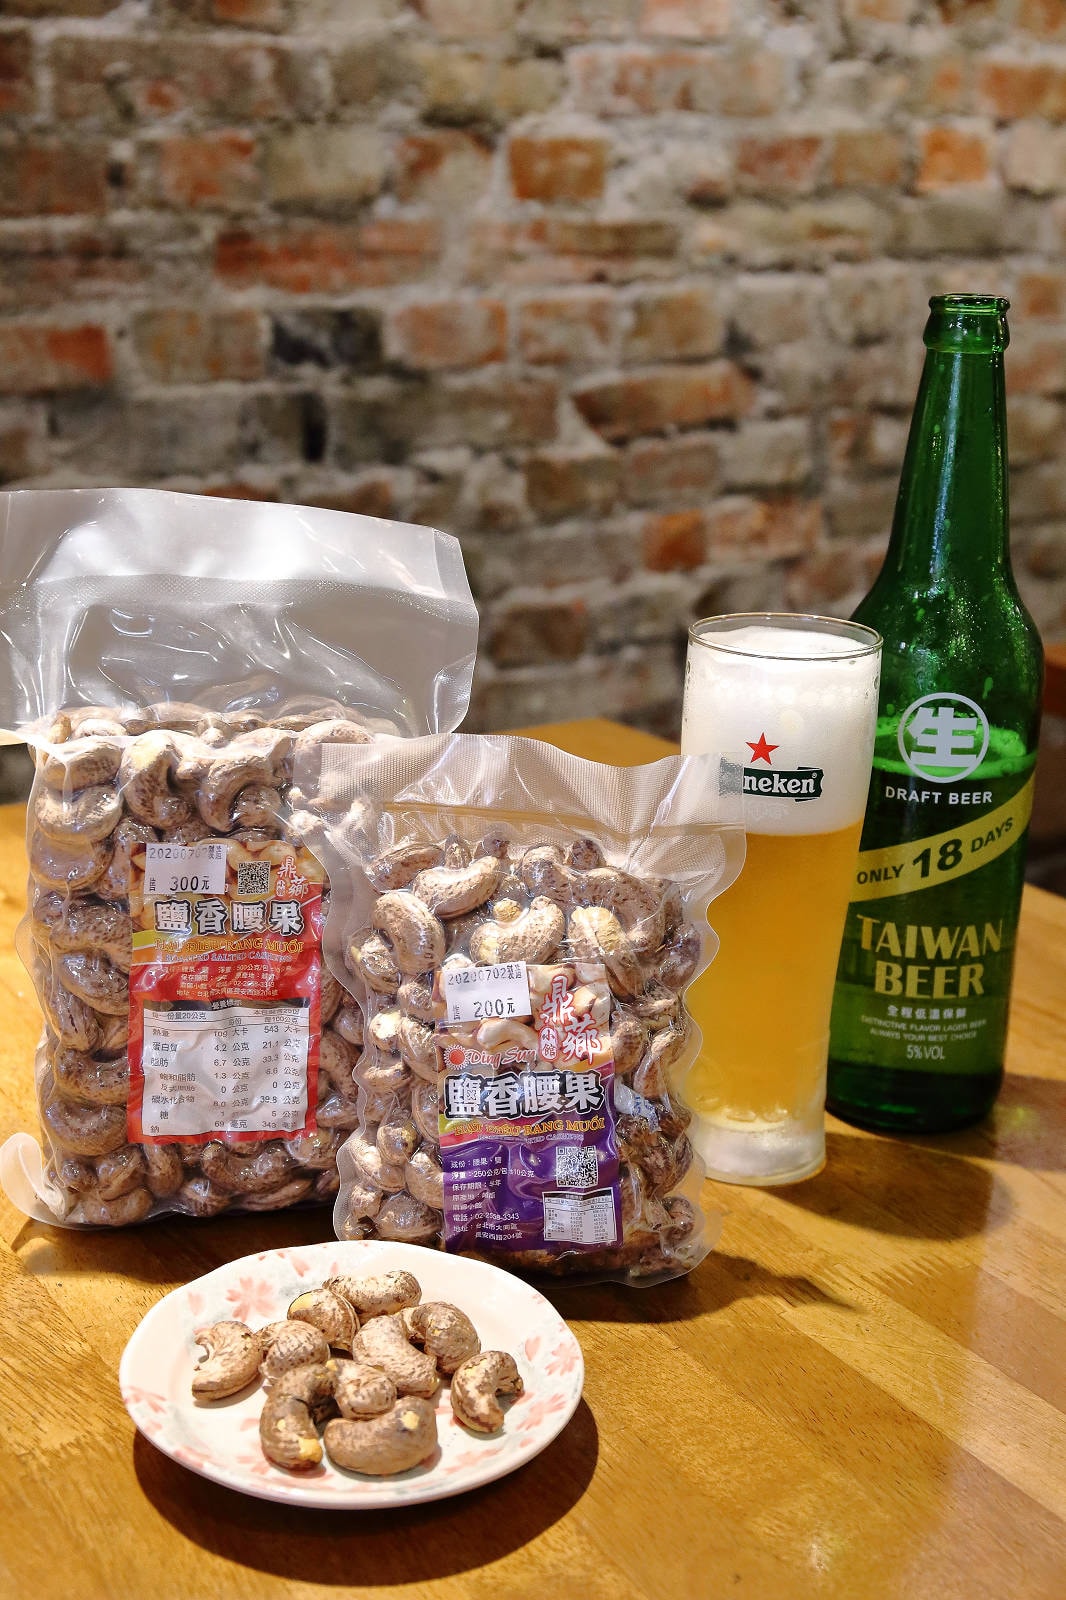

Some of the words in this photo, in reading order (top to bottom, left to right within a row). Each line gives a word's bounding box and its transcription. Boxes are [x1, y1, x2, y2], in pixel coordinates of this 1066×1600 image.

[904, 706, 979, 768] 生
[743, 773, 816, 794] neken
[885, 786, 942, 803] DRAFT
[948, 790, 993, 805] BEER
[856, 864, 905, 885] ONLY
[912, 838, 963, 879] 18
[970, 817, 1013, 853] DAYS
[170, 875, 210, 891] 300元
[154, 898, 304, 937] 鹽香腰果
[856, 914, 1003, 960] TAIWAN
[874, 960, 985, 999] BEER
[473, 997, 516, 1018] 200元
[232, 1026, 249, 1036] 大卡
[264, 1025, 279, 1034] 543
[910, 1023, 941, 1032] FLAVOR
[903, 1033, 926, 1042] YOUR
[214, 1044, 227, 1052] 4.2
[232, 1042, 250, 1052] 公克
[213, 1059, 227, 1067] 6.7
[232, 1057, 250, 1067] 公克
[284, 1053, 300, 1064] 公克
[233, 1072, 250, 1081] 公克
[284, 1067, 300, 1077] 公克
[220, 1086, 227, 1094] 0
[232, 1084, 249, 1093] 公克
[272, 1081, 278, 1089] 0
[283, 1080, 300, 1090] 公克
[232, 1099, 249, 1108] 公克
[260, 1095, 278, 1104] 39.8
[282, 1094, 300, 1105] 公克
[446, 1071, 603, 1119] 鹽香腰果
[271, 1110, 277, 1118] 5
[214, 1120, 225, 1128] 69
[230, 1119, 248, 1129] 毫克
[523, 1121, 564, 1136] RANG
